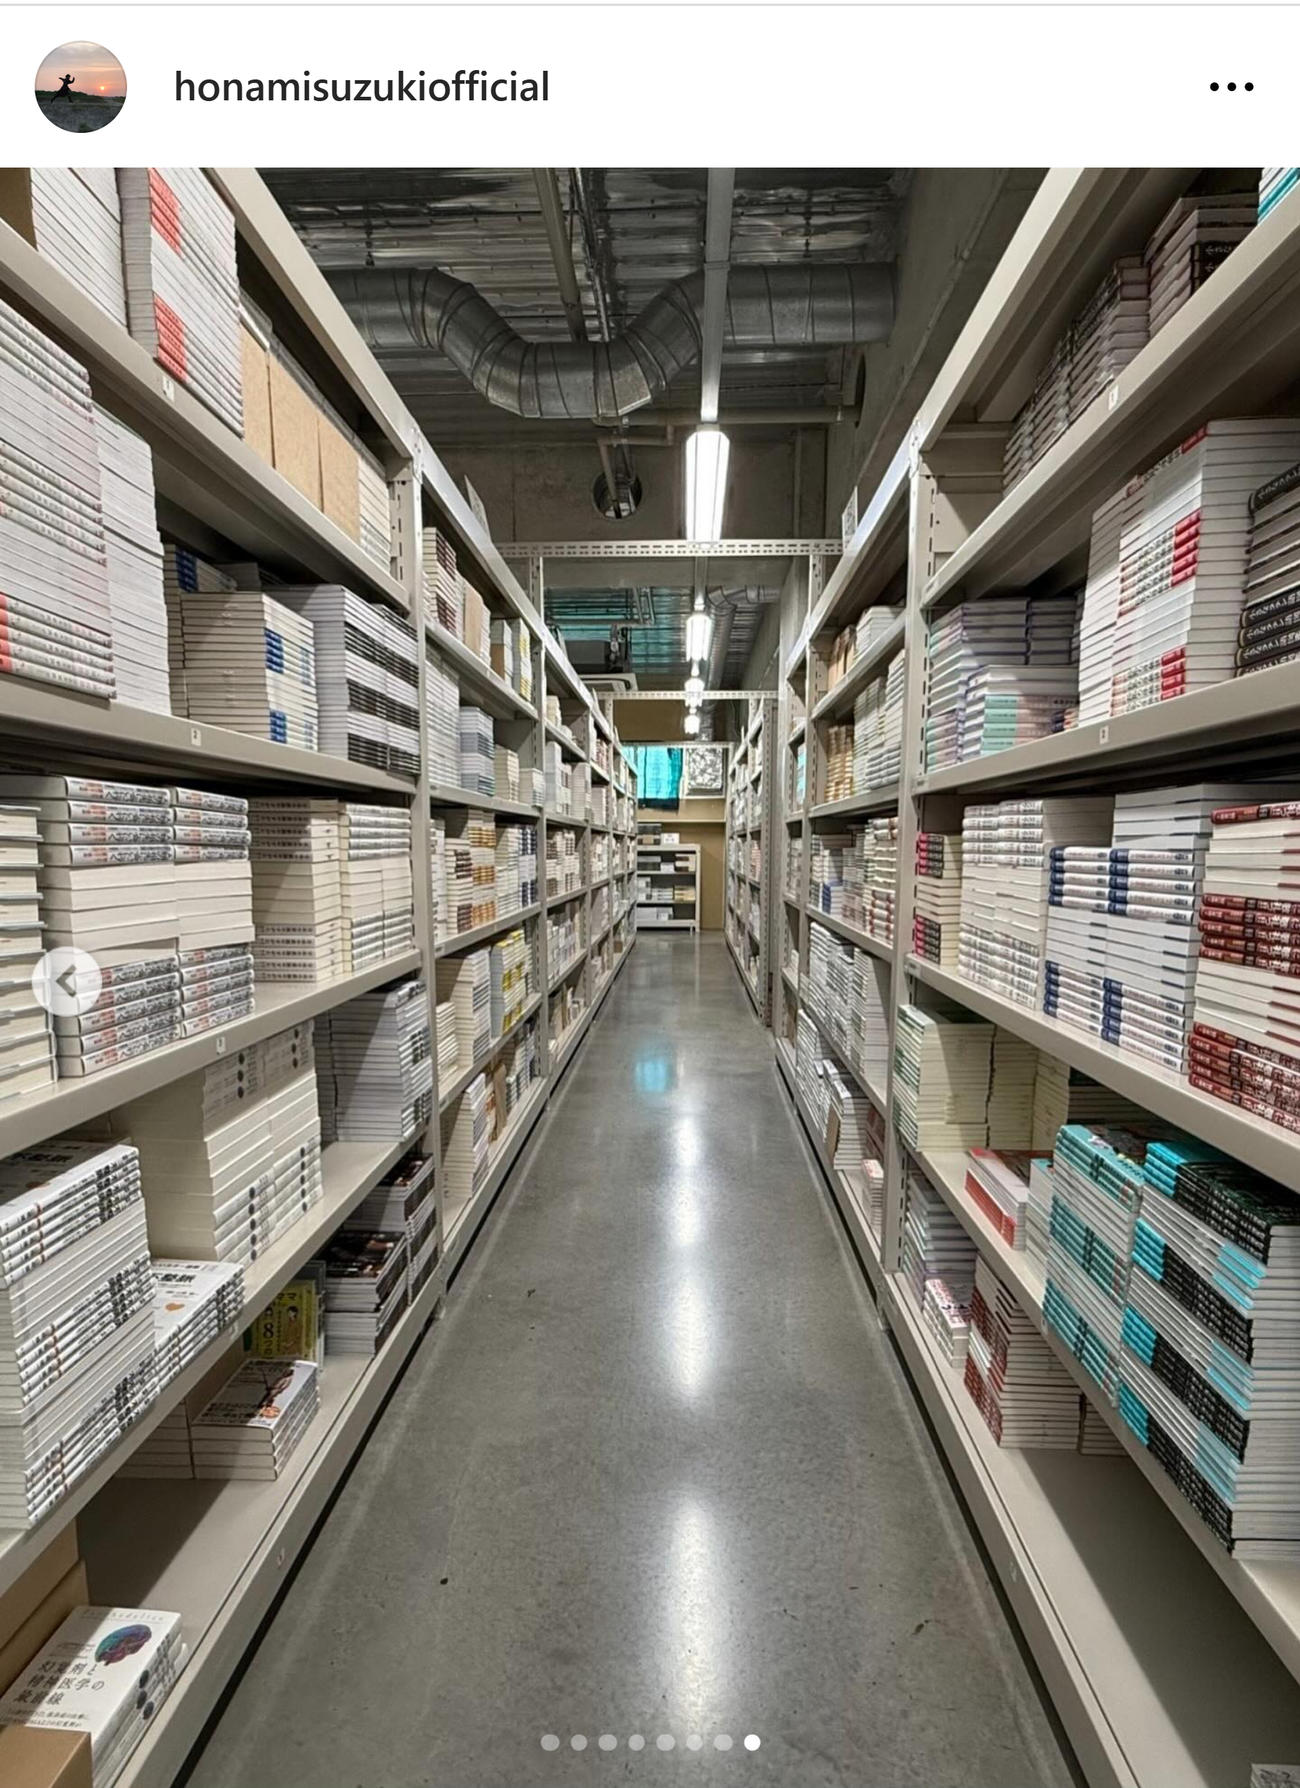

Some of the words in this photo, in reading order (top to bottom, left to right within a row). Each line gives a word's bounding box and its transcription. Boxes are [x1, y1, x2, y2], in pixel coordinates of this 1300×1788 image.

[26, 1673, 105, 1691] 精神医学の
